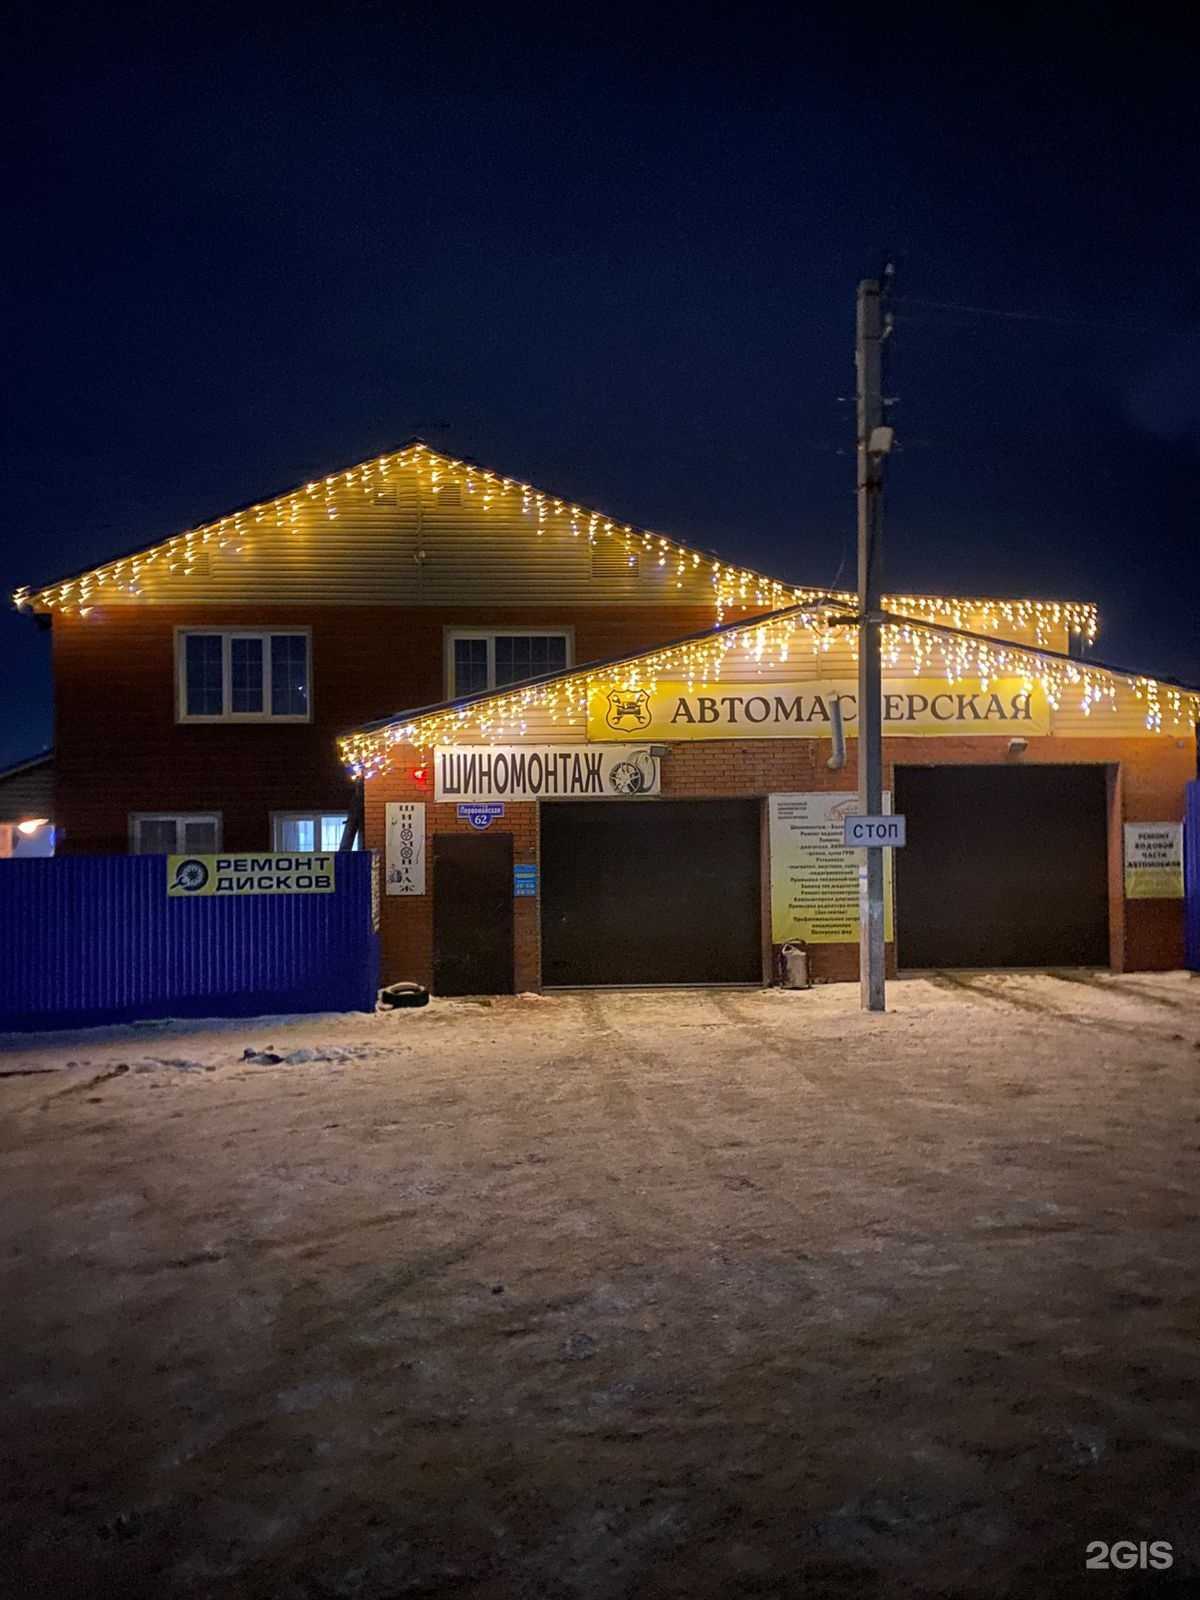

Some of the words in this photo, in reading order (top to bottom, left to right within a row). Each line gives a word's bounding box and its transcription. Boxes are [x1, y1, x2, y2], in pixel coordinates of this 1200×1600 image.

[671, 693, 1033, 724] АВТОМАСЕРСКАЯ
[441, 753, 604, 794] ШИНОМОНТАЖ
[474, 814, 488, 825] 62
[852, 823, 899, 838] СТОП
[215, 857, 331, 873] РЕМОНТ
[215, 875, 332, 892] ДИСКОВ
